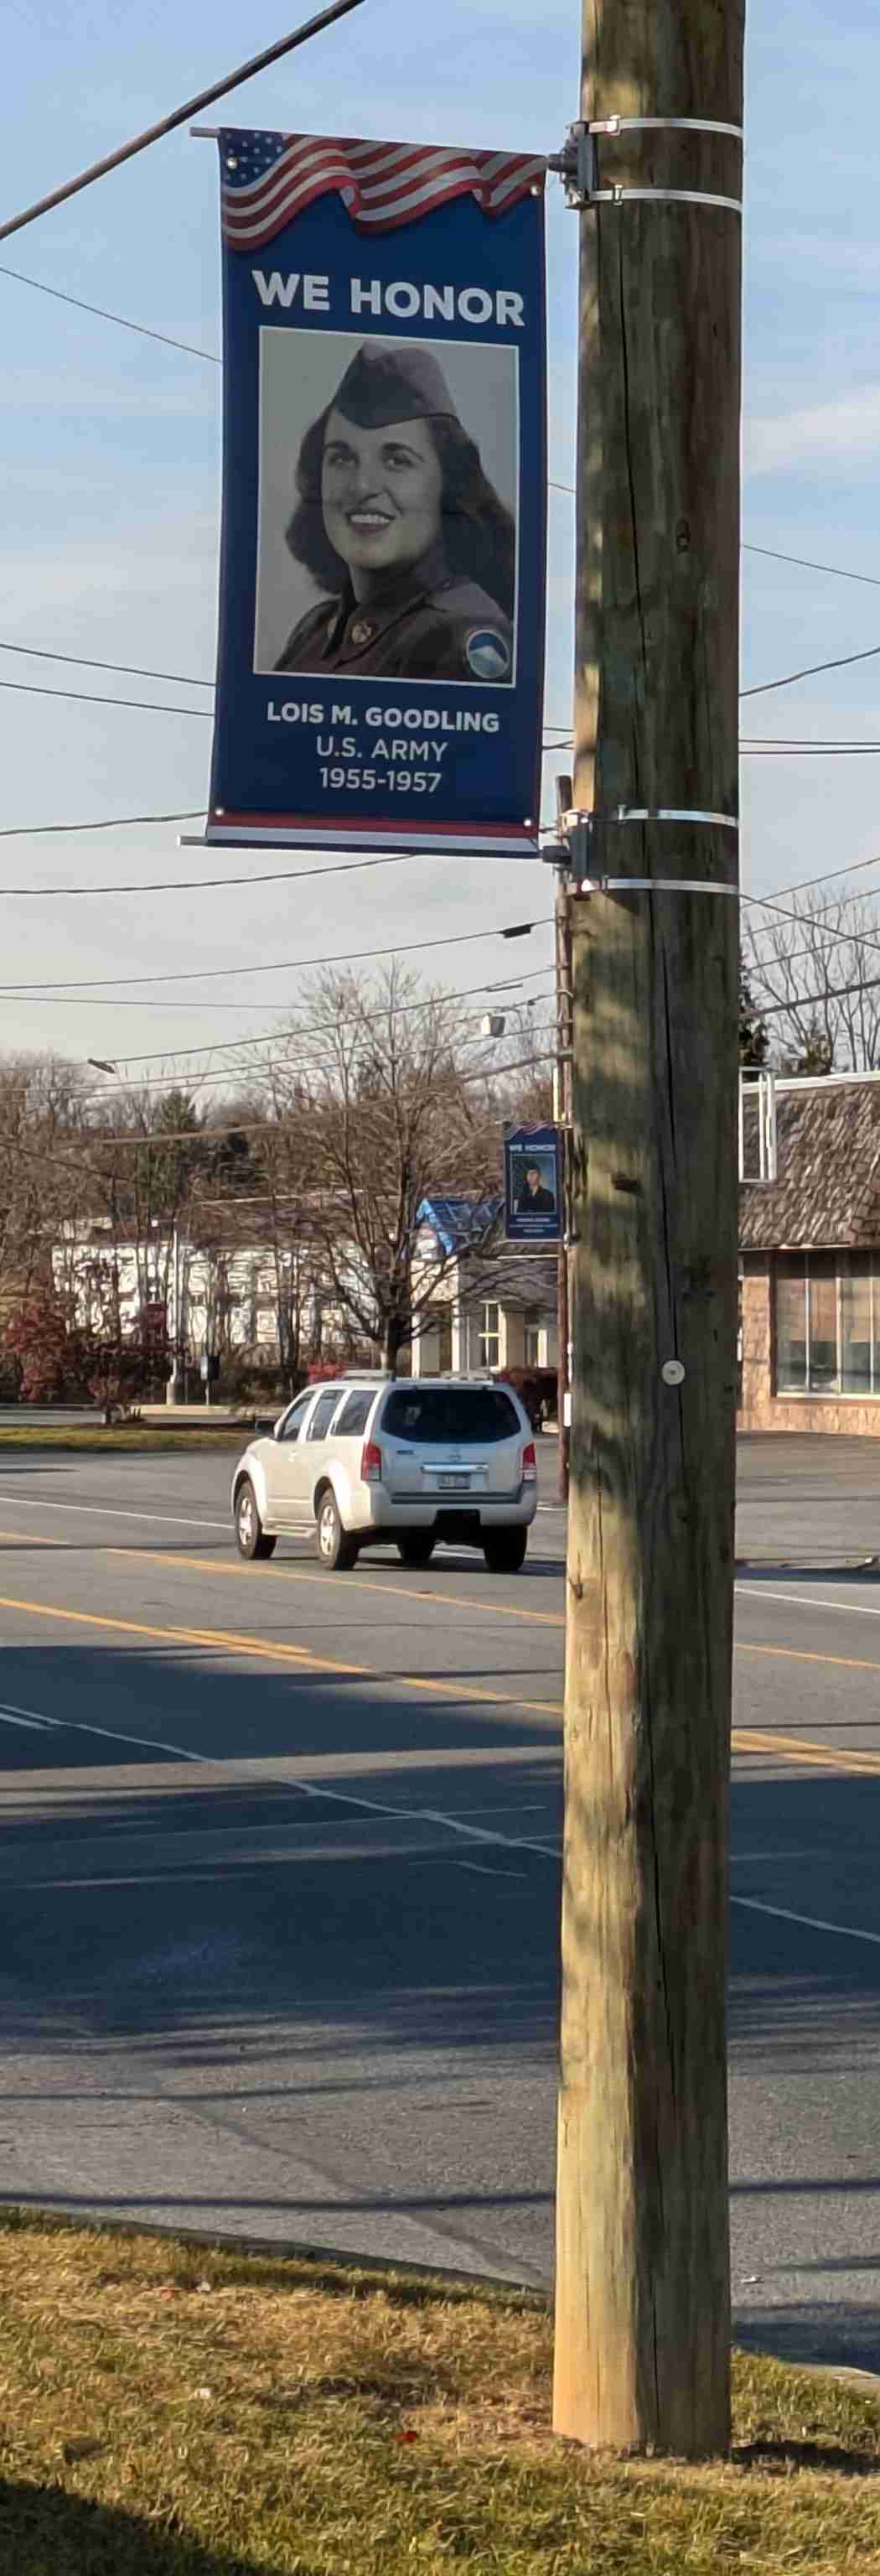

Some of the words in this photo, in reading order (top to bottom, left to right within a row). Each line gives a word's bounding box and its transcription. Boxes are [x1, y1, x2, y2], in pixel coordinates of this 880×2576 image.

[252, 270, 330, 311] WE
[351, 278, 525, 326] HONOR
[267, 702, 324, 724] LOIS
[331, 705, 358, 726] M.
[365, 707, 500, 734] GOODLING
[317, 735, 362, 759] U.S.
[371, 739, 448, 761] ARMY
[320, 767, 442, 792] 1955-1957
